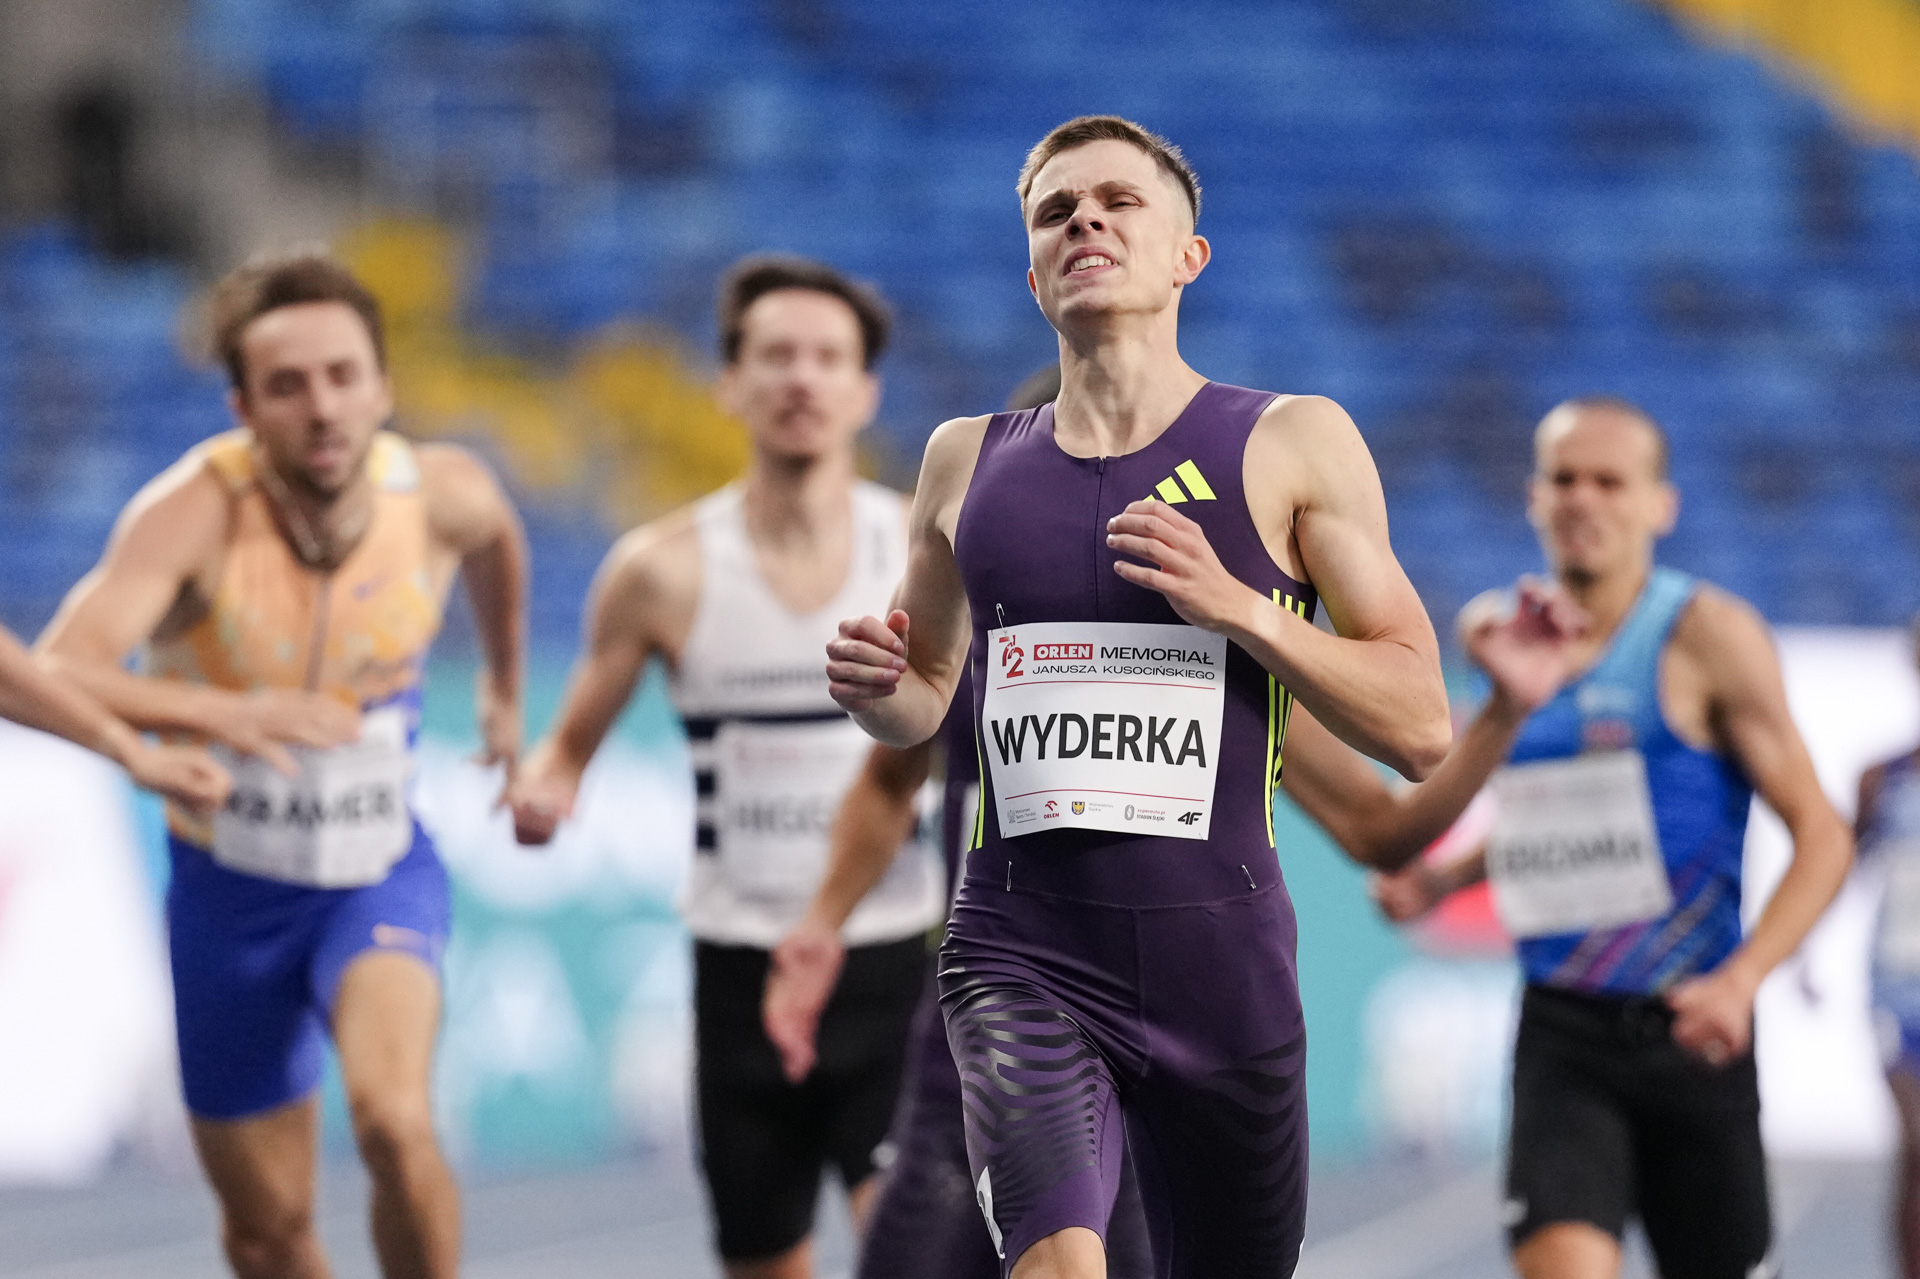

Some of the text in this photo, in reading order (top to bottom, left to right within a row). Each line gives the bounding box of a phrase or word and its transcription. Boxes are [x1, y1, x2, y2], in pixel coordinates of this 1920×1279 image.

[1035, 645, 1215, 665] ORLEN MEMORIAŁ
[1032, 665, 1215, 680] JANUSZA KUSOCIŃSKIEGO
[991, 713, 1206, 768] WYDERKA
[1177, 811, 1203, 825] 4F
